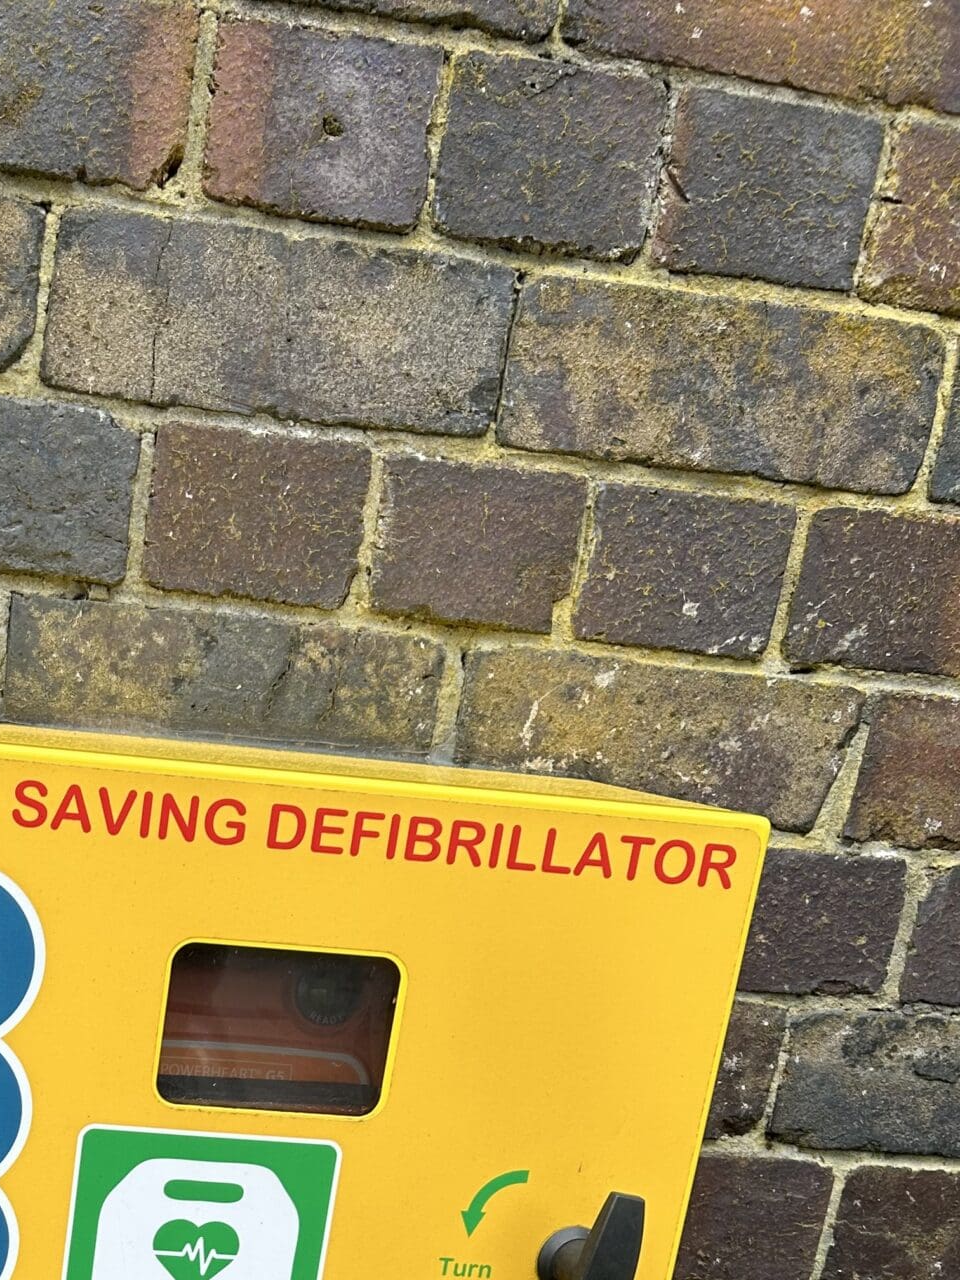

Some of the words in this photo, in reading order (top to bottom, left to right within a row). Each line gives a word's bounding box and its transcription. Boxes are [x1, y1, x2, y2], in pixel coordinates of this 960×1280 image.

[12, 779, 247, 846] SAVING
[266, 802, 738, 890] DEFIBRILLATOR
[439, 1257, 492, 1279] Turn
